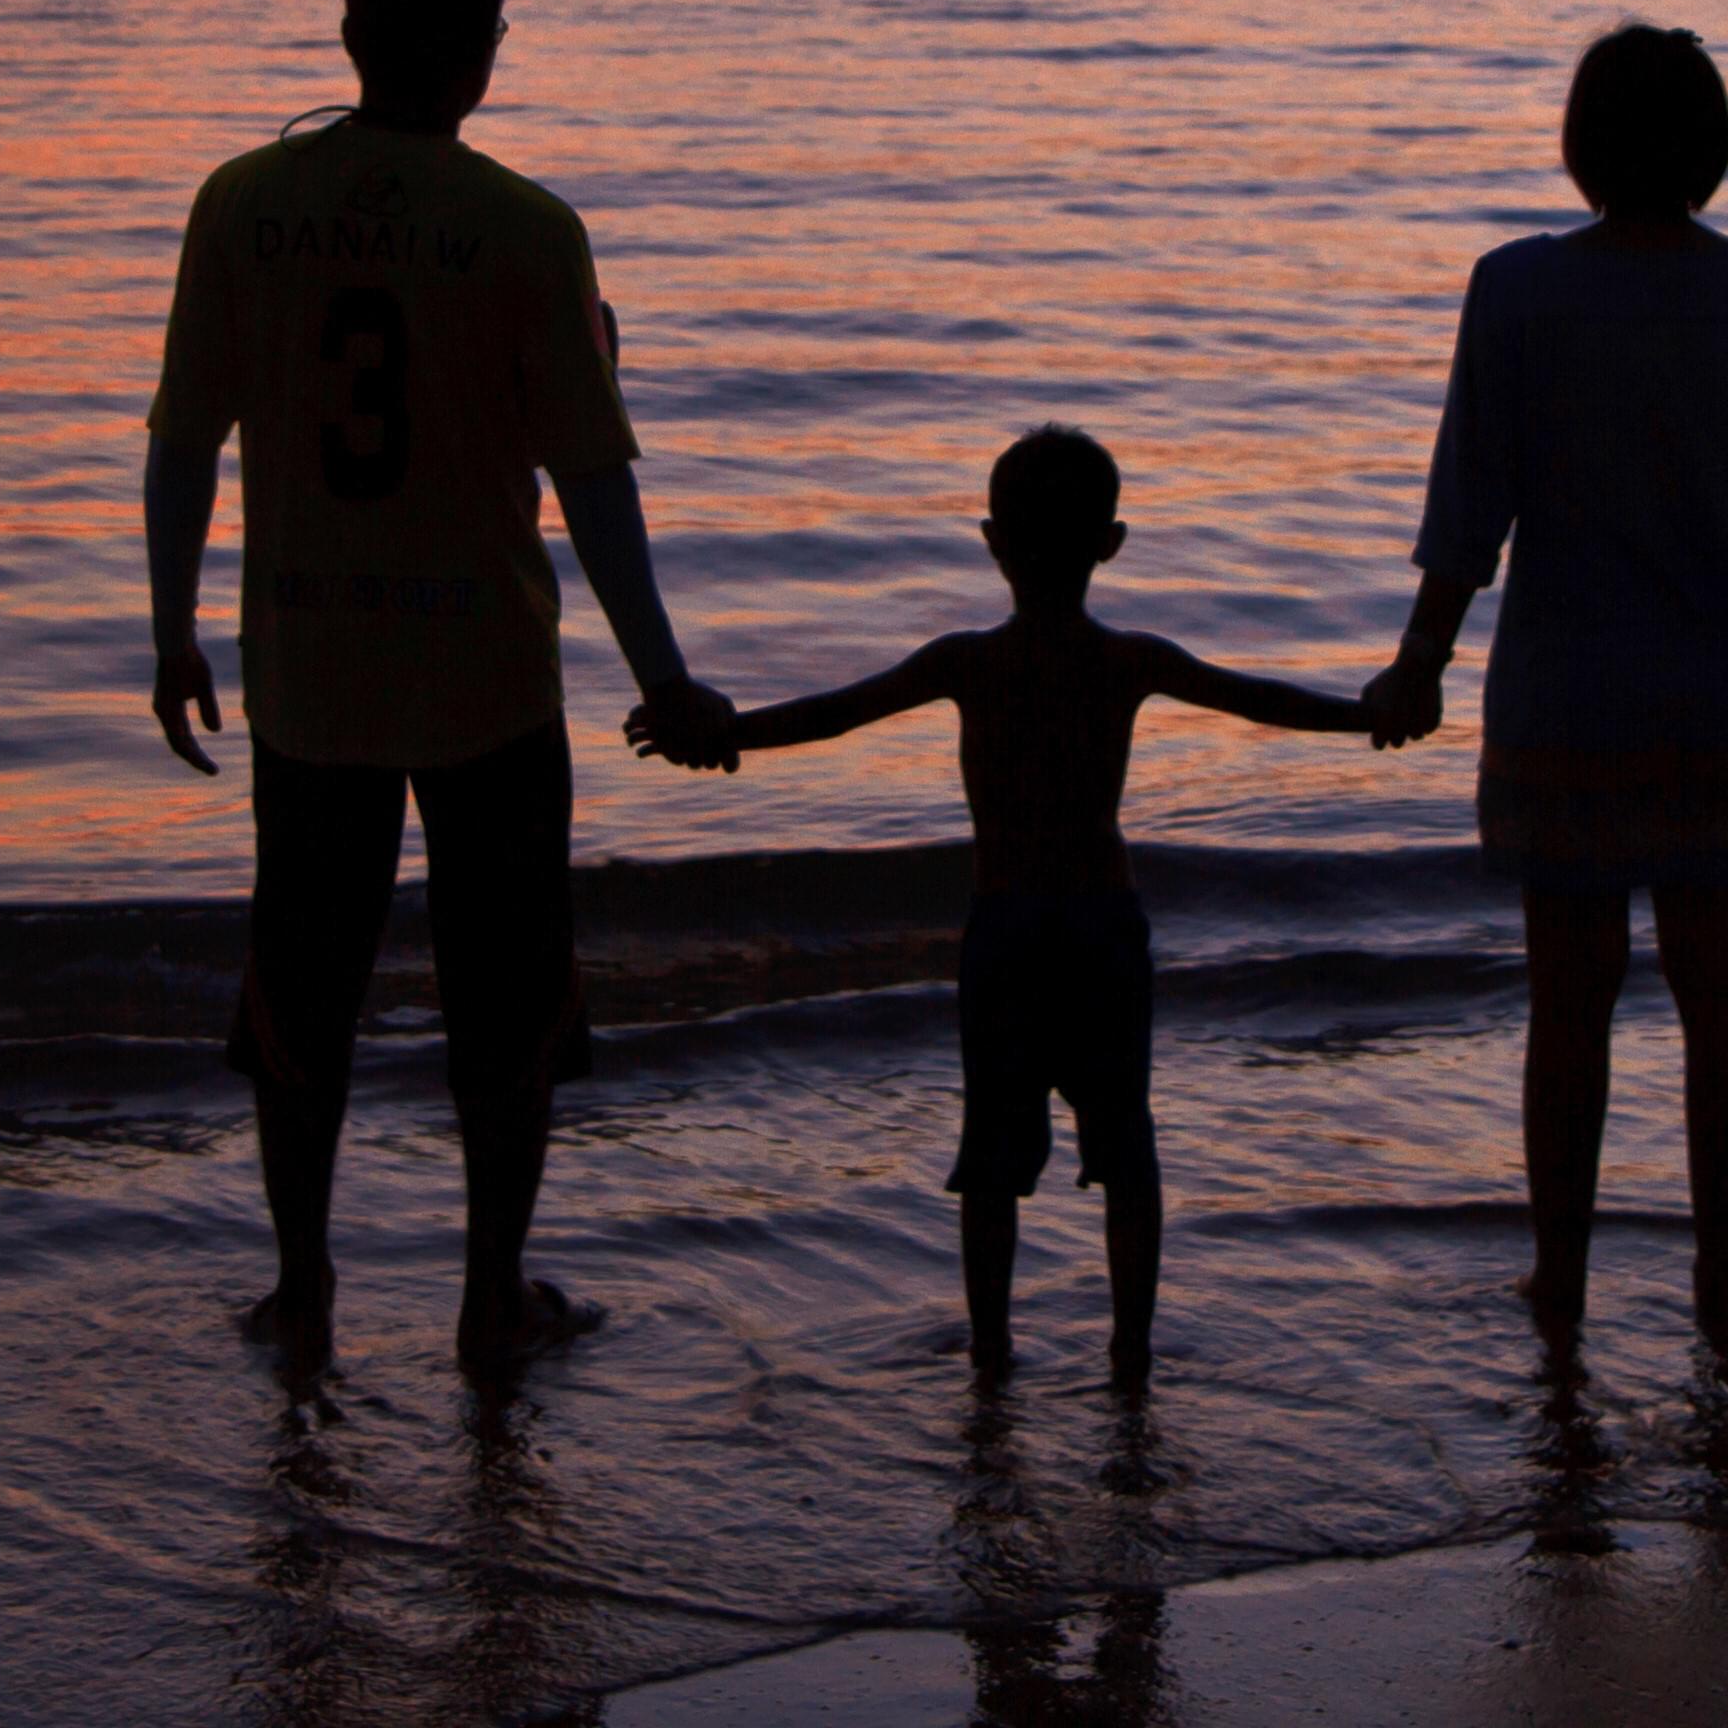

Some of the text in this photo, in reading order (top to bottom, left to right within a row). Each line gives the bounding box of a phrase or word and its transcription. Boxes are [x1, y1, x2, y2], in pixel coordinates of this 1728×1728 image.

[254, 215, 482, 274] DANAI W
[319, 287, 410, 499] 3
